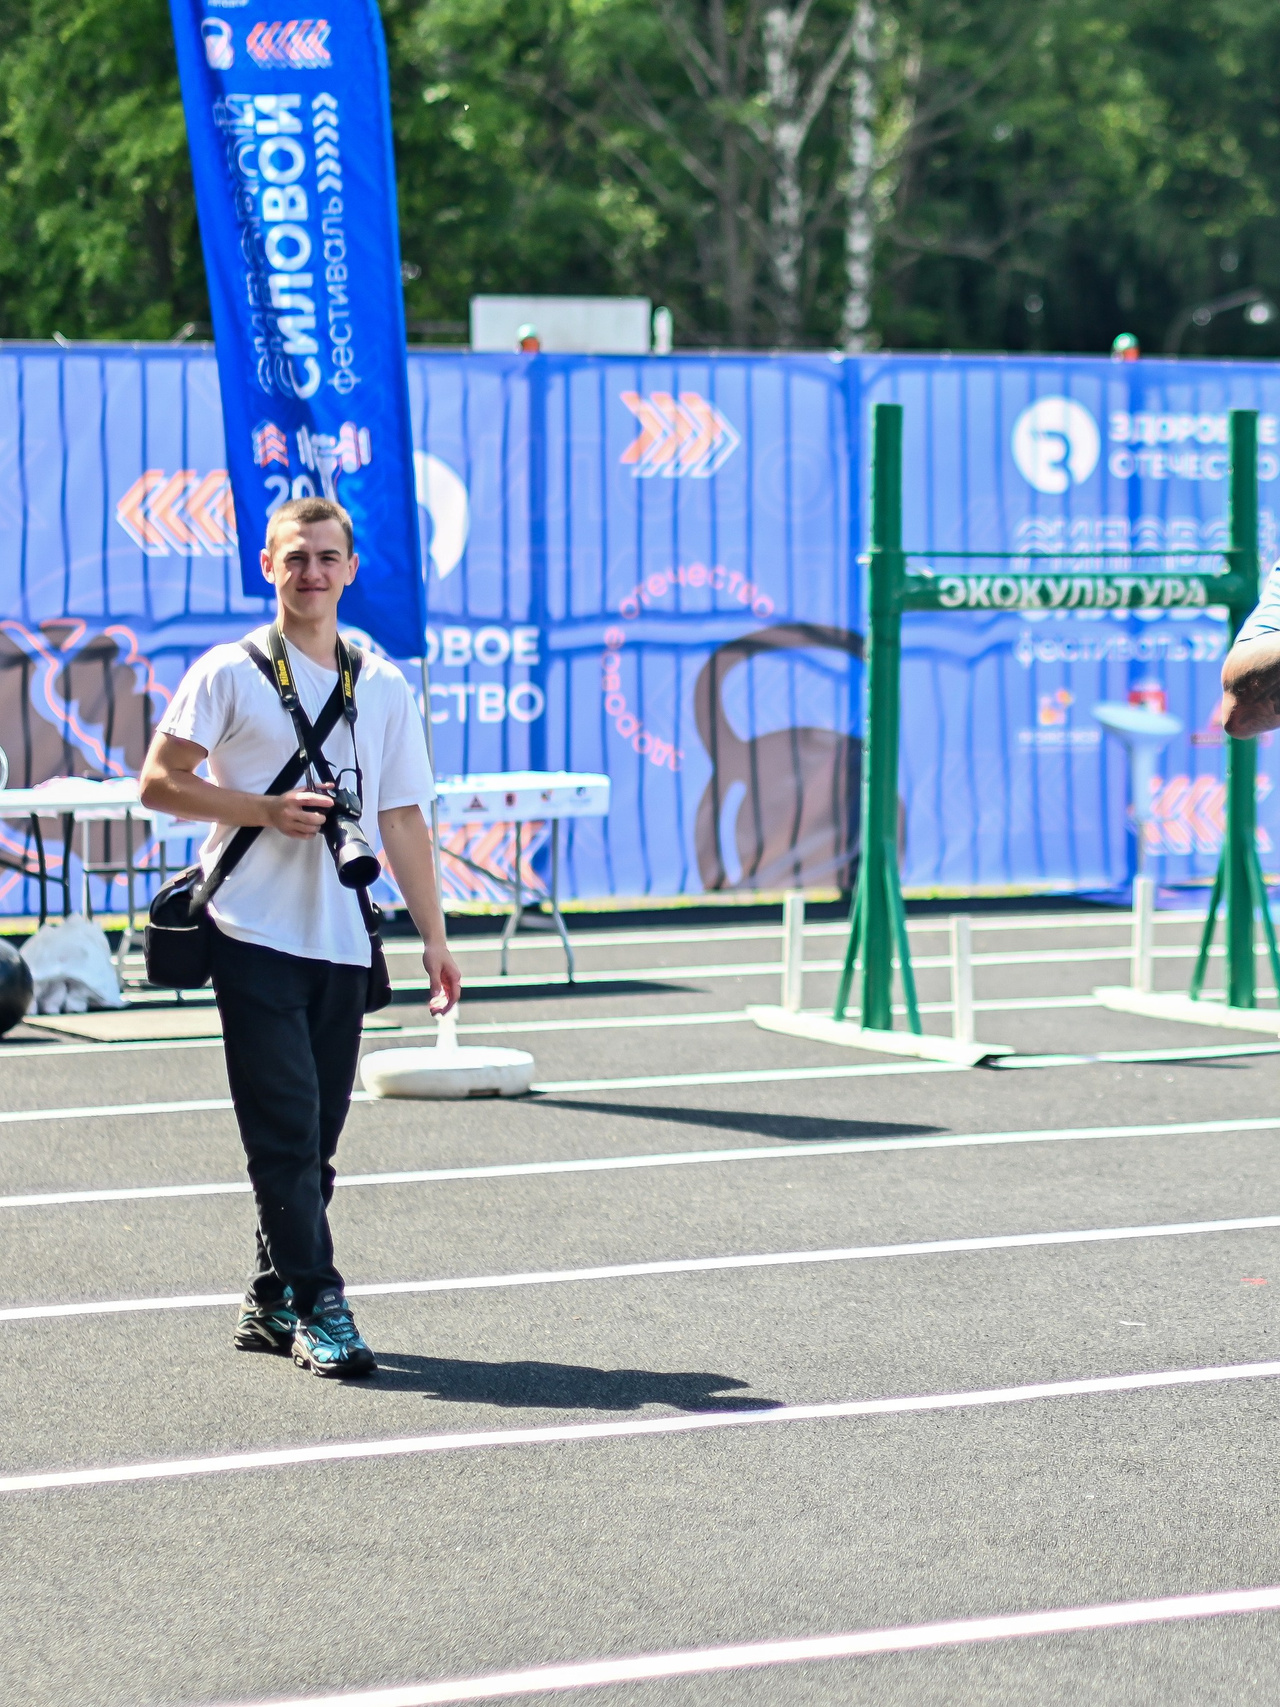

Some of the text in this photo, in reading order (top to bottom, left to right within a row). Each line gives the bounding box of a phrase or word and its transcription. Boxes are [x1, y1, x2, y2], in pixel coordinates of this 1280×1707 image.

[322, 196, 362, 395] фестиваль
[1108, 449, 1280, 481] ОТЕЧЕСО
[619, 562, 774, 618] отечество
[937, 576, 1209, 609] ЭКОКУЛЬТУРА
[419, 682, 544, 724] СТВО
